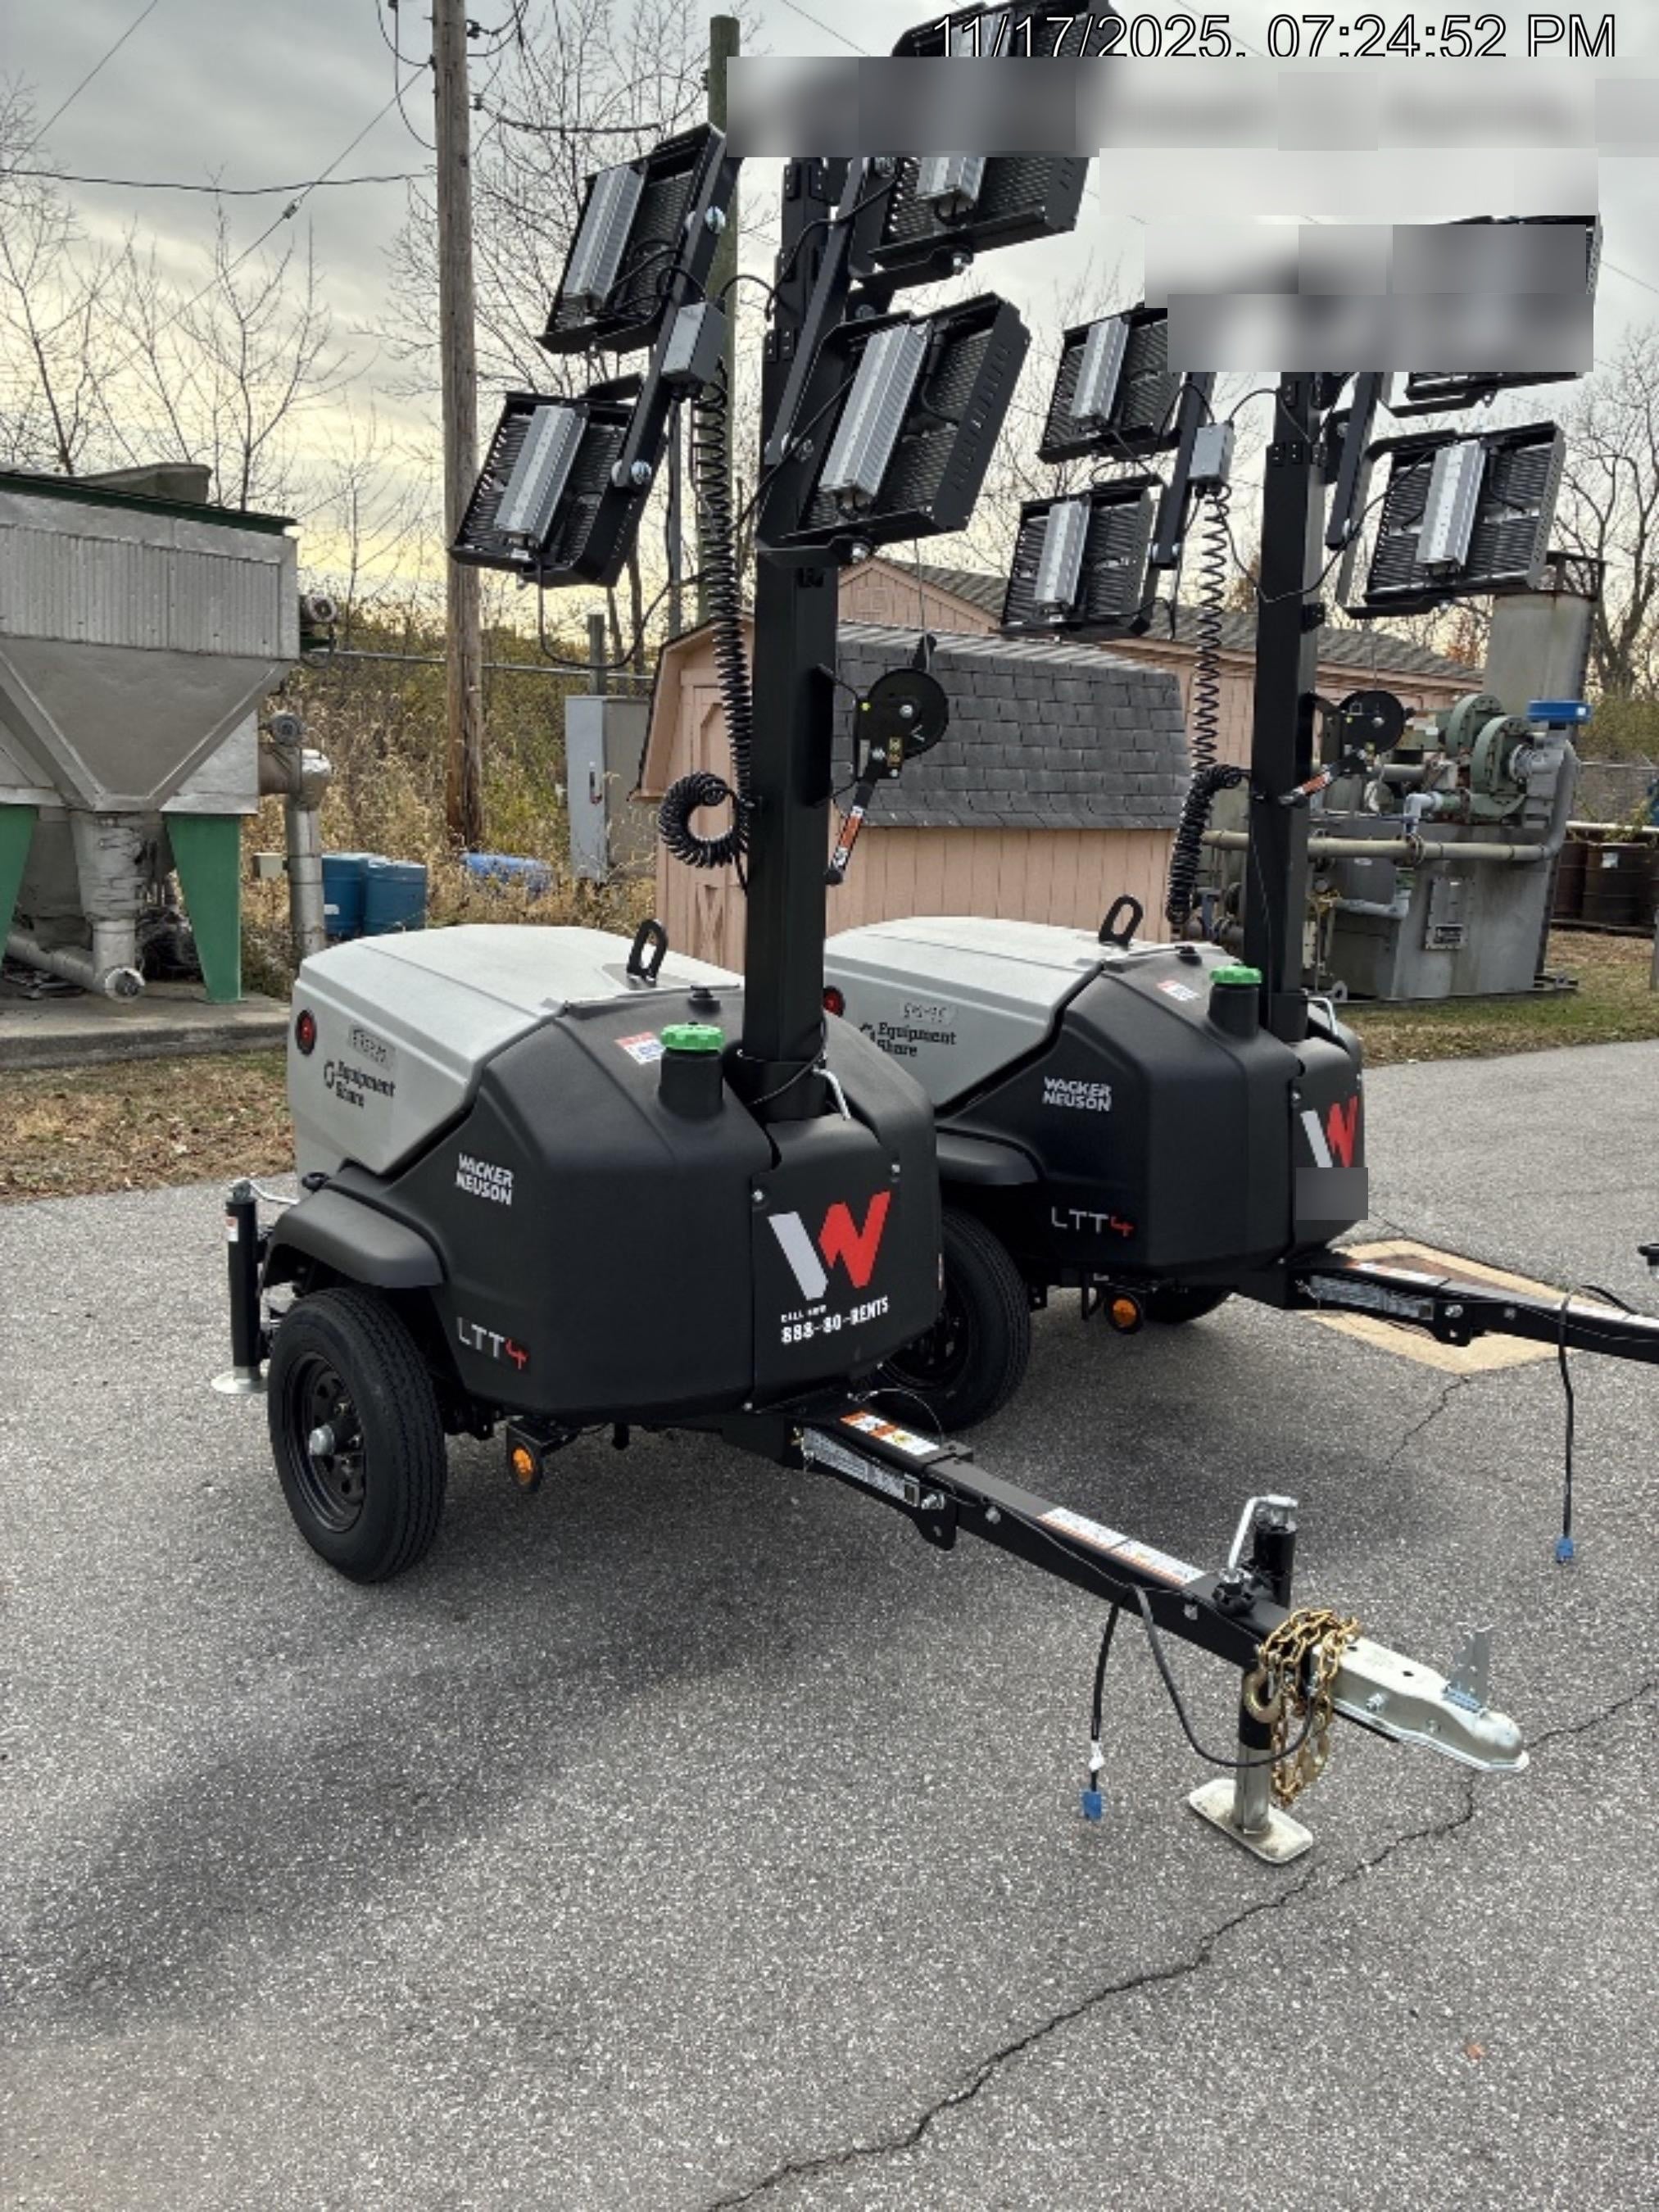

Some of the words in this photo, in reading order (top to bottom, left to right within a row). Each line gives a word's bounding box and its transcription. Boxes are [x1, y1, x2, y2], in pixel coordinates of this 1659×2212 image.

[877, 1022, 957, 1045] Equipment
[1042, 1090, 1113, 1113] NEUSON
[1044, 1075, 1112, 1097] WACKER
[458, 1151, 513, 1188] WACKER
[456, 1169, 512, 1206] NEUSON
[1051, 1206, 1134, 1238] LTT4
[457, 1317, 527, 1371] LTT4
